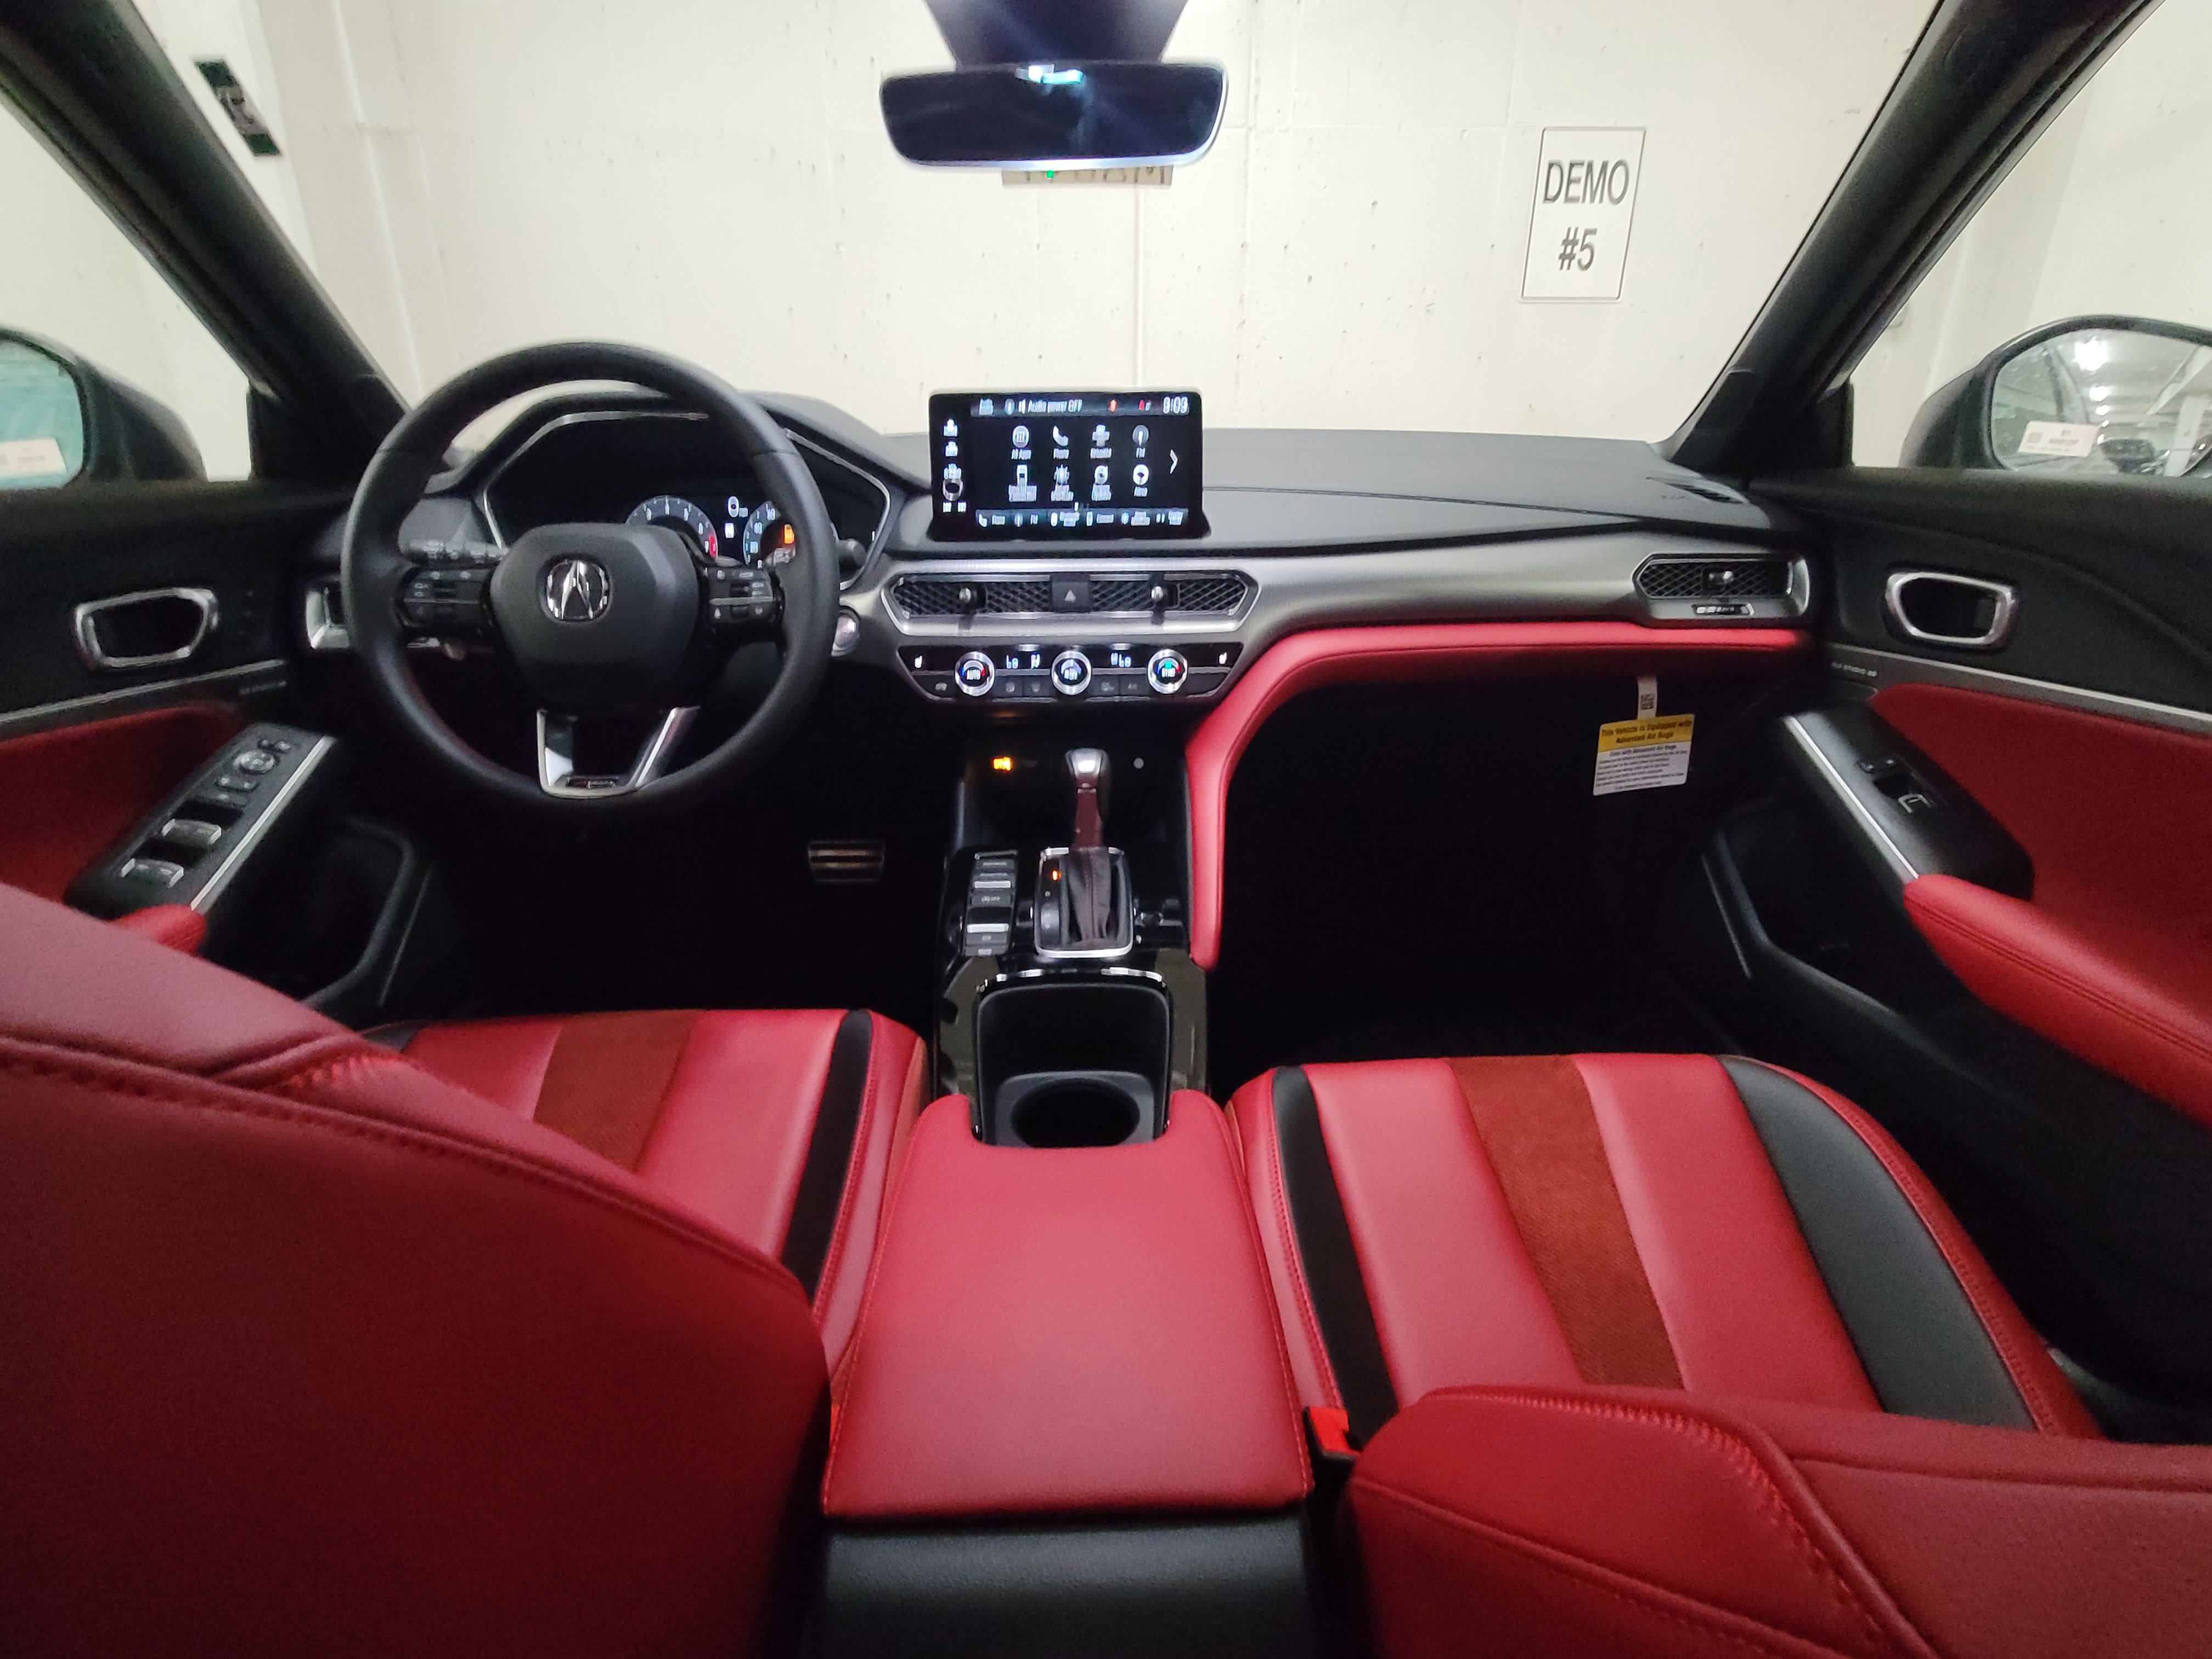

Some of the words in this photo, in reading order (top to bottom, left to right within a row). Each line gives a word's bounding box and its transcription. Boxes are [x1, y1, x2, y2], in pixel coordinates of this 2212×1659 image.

[1542, 159, 1630, 205] DEMO
[1558, 227, 1598, 272] #5
[966, 669, 981, 680] AUTO
